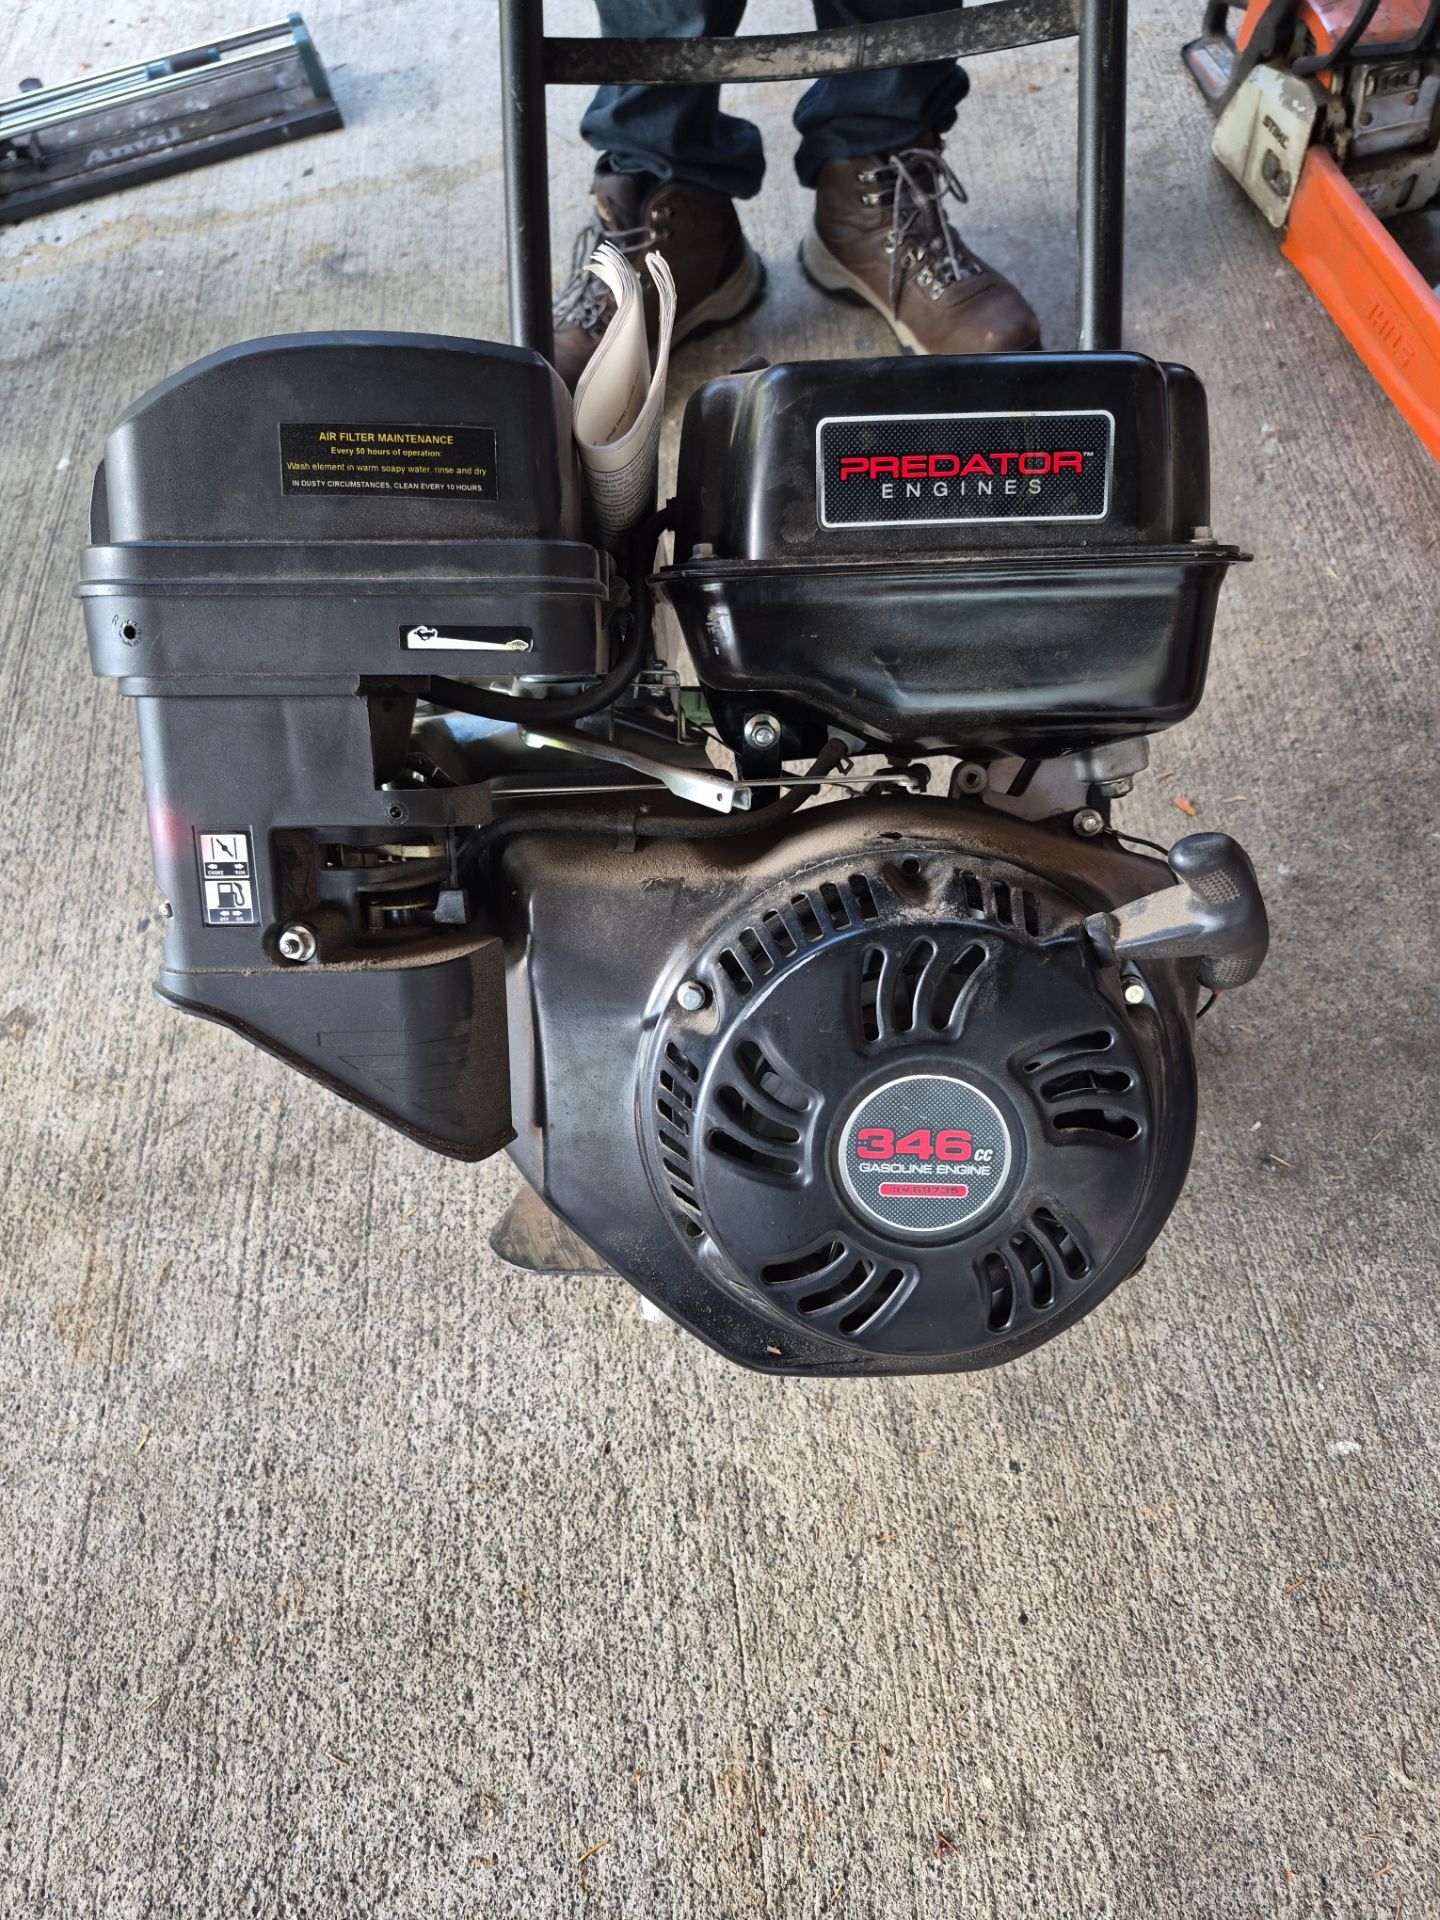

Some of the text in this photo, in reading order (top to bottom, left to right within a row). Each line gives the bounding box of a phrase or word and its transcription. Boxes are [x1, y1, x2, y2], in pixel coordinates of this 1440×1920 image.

[319, 432, 454, 444] AIR FILTER MAINTENANCE
[331, 447, 354, 456] Every
[356, 447, 365, 455] 50
[368, 448, 390, 456] hours
[392, 448, 401, 456] of
[287, 462, 310, 471] Wash
[312, 463, 345, 472] element
[347, 463, 354, 471] in
[381, 465, 406, 475] soapy
[434, 466, 454, 475] rinse
[456, 467, 472, 475] and
[474, 467, 487, 477] dry
[840, 451, 1083, 481] PREDATOR
[420, 482, 445, 490] EVERY
[447, 483, 455, 491] 10
[882, 480, 1041, 499] ENGINES
[857, 1128, 972, 1161] 346
[859, 1163, 992, 1175] GASOLINE ENGINE
